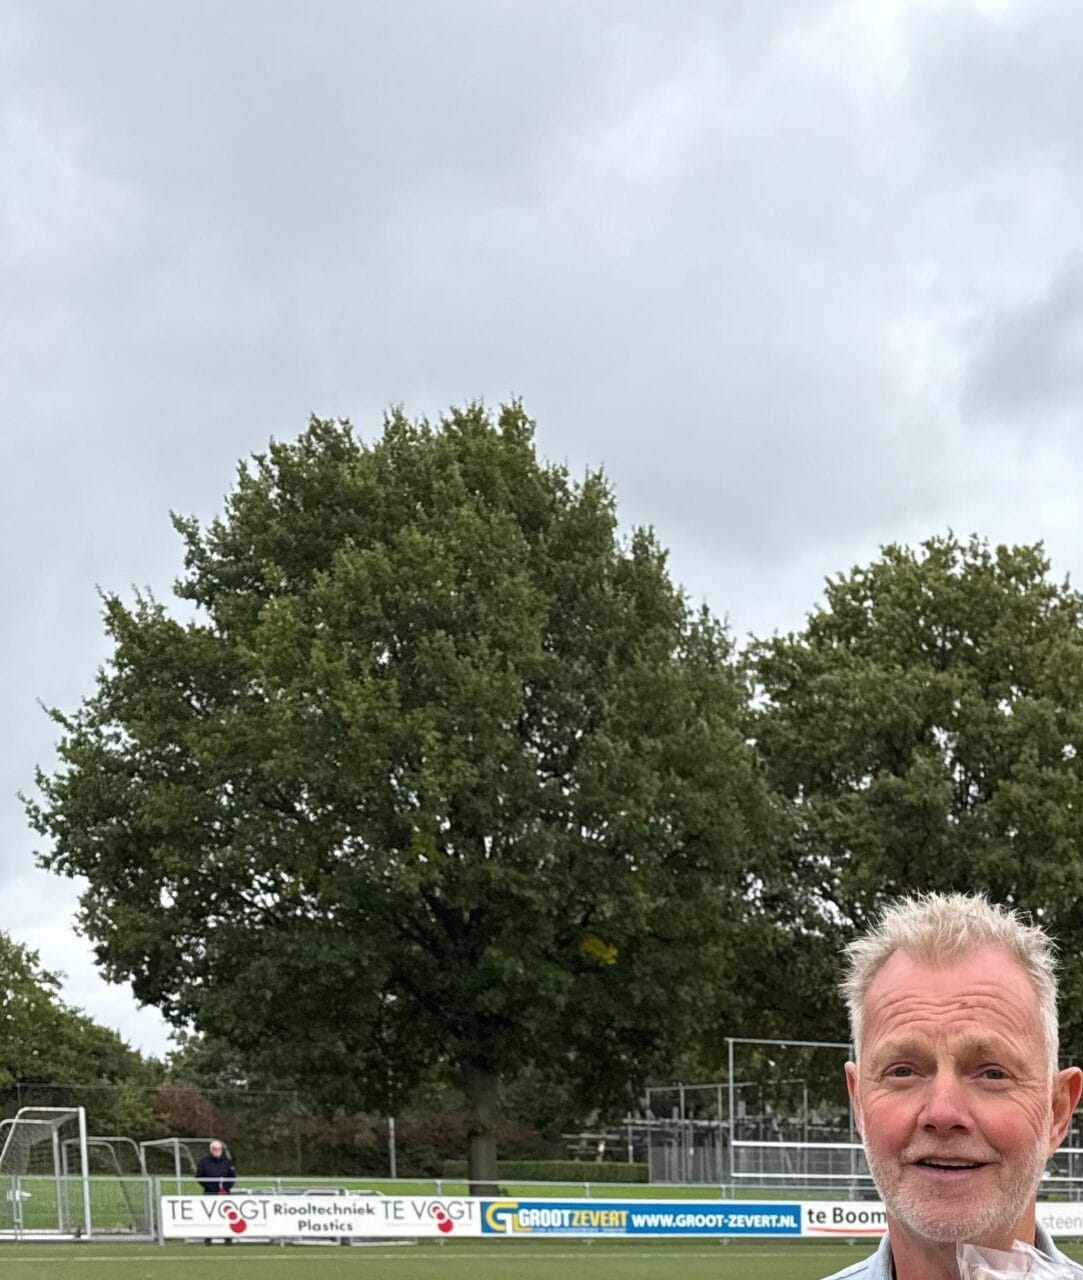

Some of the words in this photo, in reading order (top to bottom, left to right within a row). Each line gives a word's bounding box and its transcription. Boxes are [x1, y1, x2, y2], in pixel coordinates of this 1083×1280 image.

[167, 1200, 193, 1220] TE
[200, 1200, 271, 1220] VOGT
[274, 1202, 376, 1216] Riooltechniek
[380, 1201, 405, 1220] TE
[408, 1201, 476, 1220] VOGT
[807, 1208, 827, 1224] te
[297, 1219, 354, 1233] Plastics
[631, 1209, 799, 1229] WWW.GROOT-ZEVERT.NL
